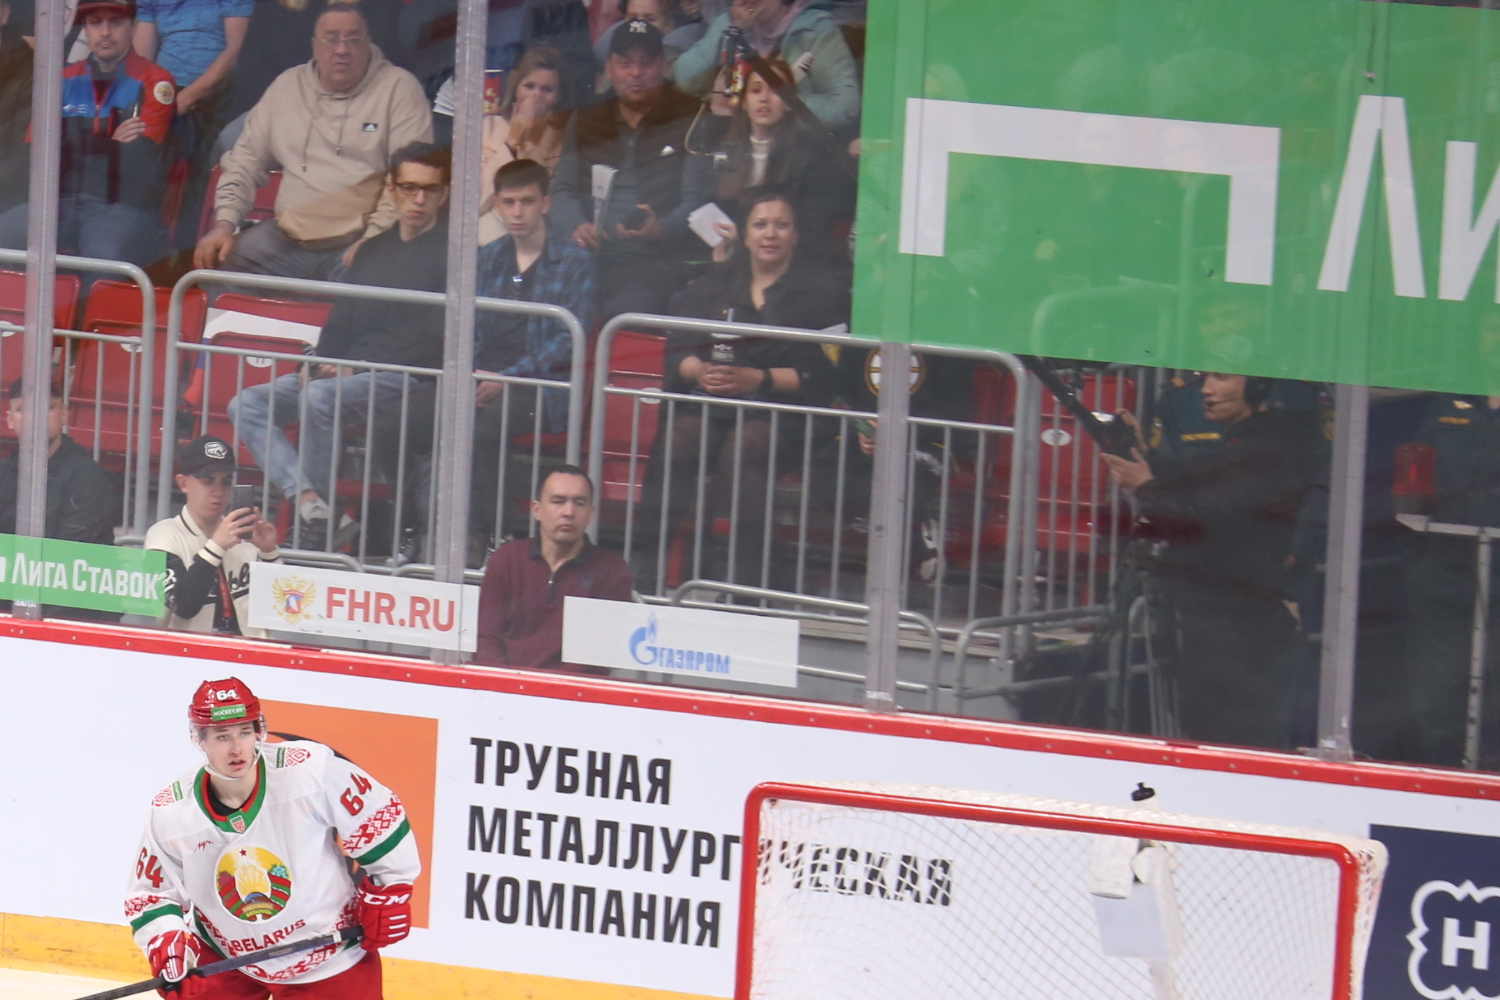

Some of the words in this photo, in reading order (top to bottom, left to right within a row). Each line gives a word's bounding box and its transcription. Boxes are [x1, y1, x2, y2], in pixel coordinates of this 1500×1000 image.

[325, 586, 456, 632] FHR.RU
[658, 646, 731, 675] ГАЗПРОМ
[215, 688, 238, 701] 64
[469, 736, 673, 806] ТРУБНАЯ
[339, 772, 373, 816] 64
[135, 846, 164, 889] 64
[464, 871, 723, 949] КОМПАНИЯ
[230, 918, 307, 953] BELARUS
